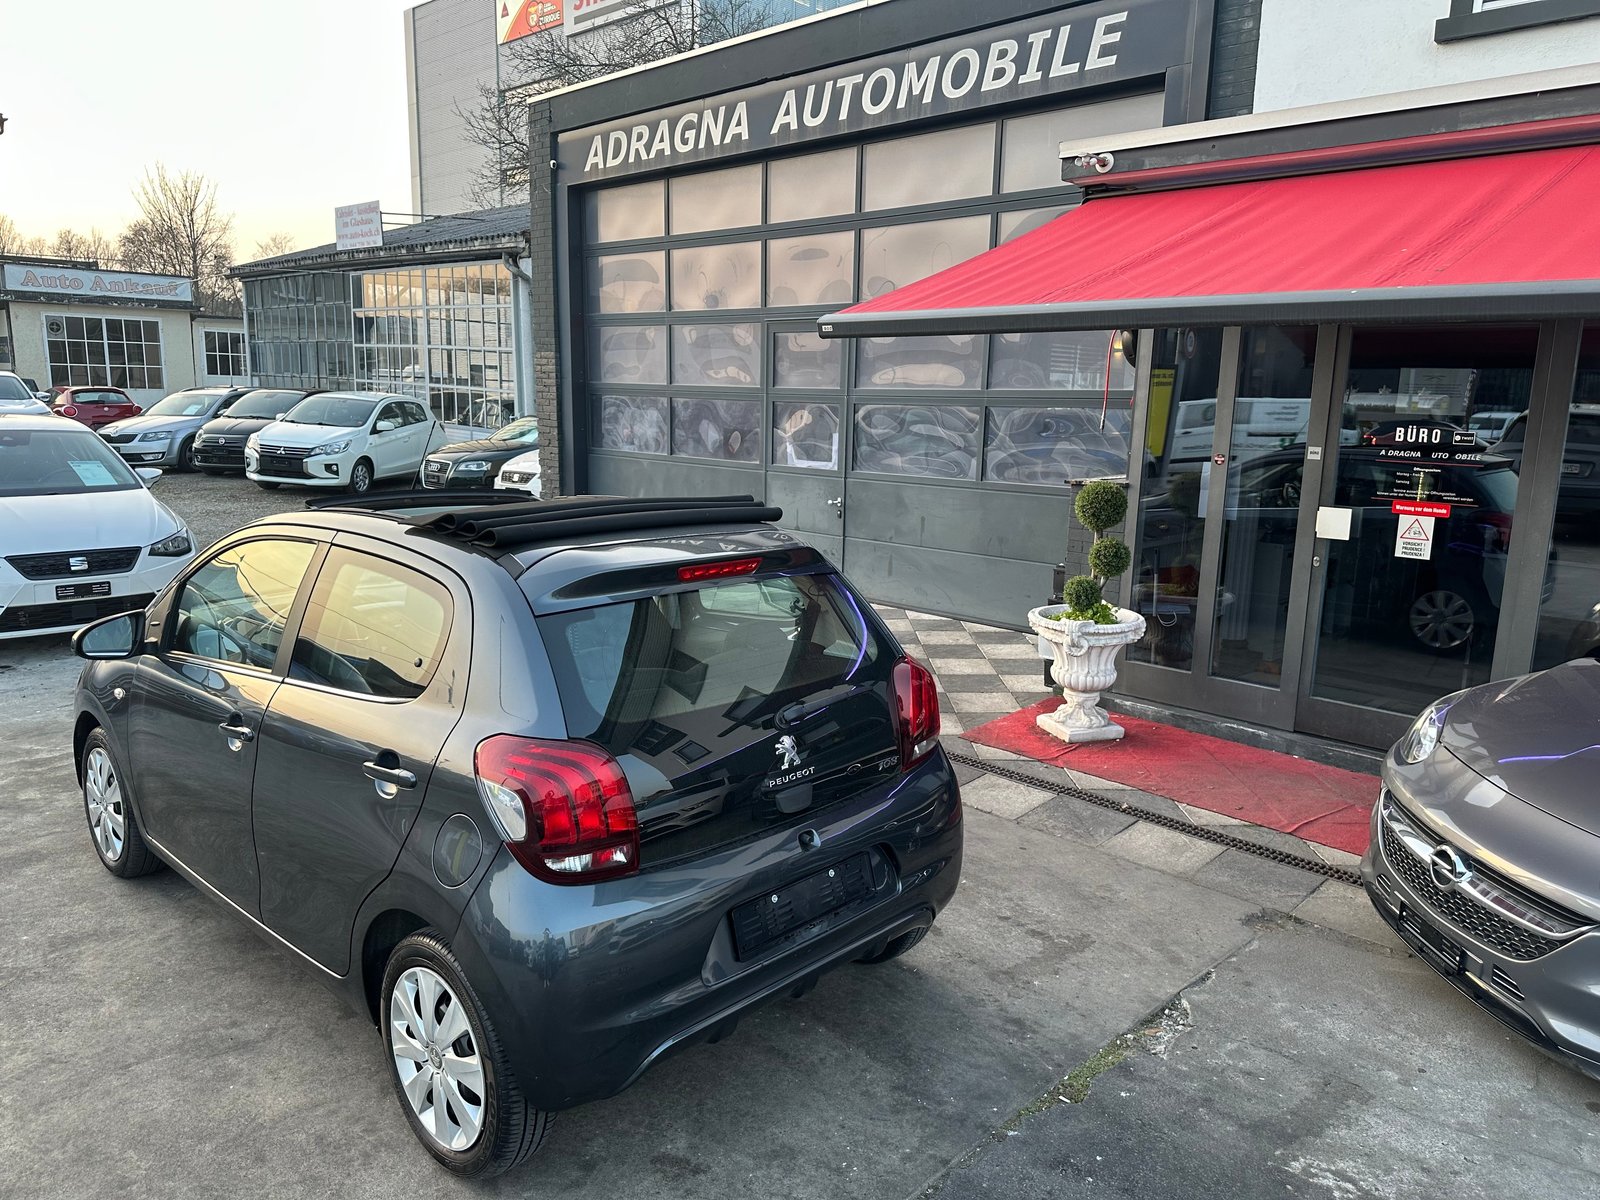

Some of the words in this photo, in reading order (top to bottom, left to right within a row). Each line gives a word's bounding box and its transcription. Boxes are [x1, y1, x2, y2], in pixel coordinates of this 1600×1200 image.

[538, 10, 561, 26] ZURIQUE
[584, 101, 750, 172] ADRAGNA
[771, 11, 1129, 136] AUTOMOBILE
[20, 269, 84, 290] Auto
[89, 275, 179, 297] Ankauf
[1394, 425, 1441, 444] BÜRO
[1454, 453, 1482, 461] OBILE
[1395, 504, 1415, 512] Warnung
[1433, 506, 1448, 514] Hunde
[769, 766, 816, 788] PEUGEOT
